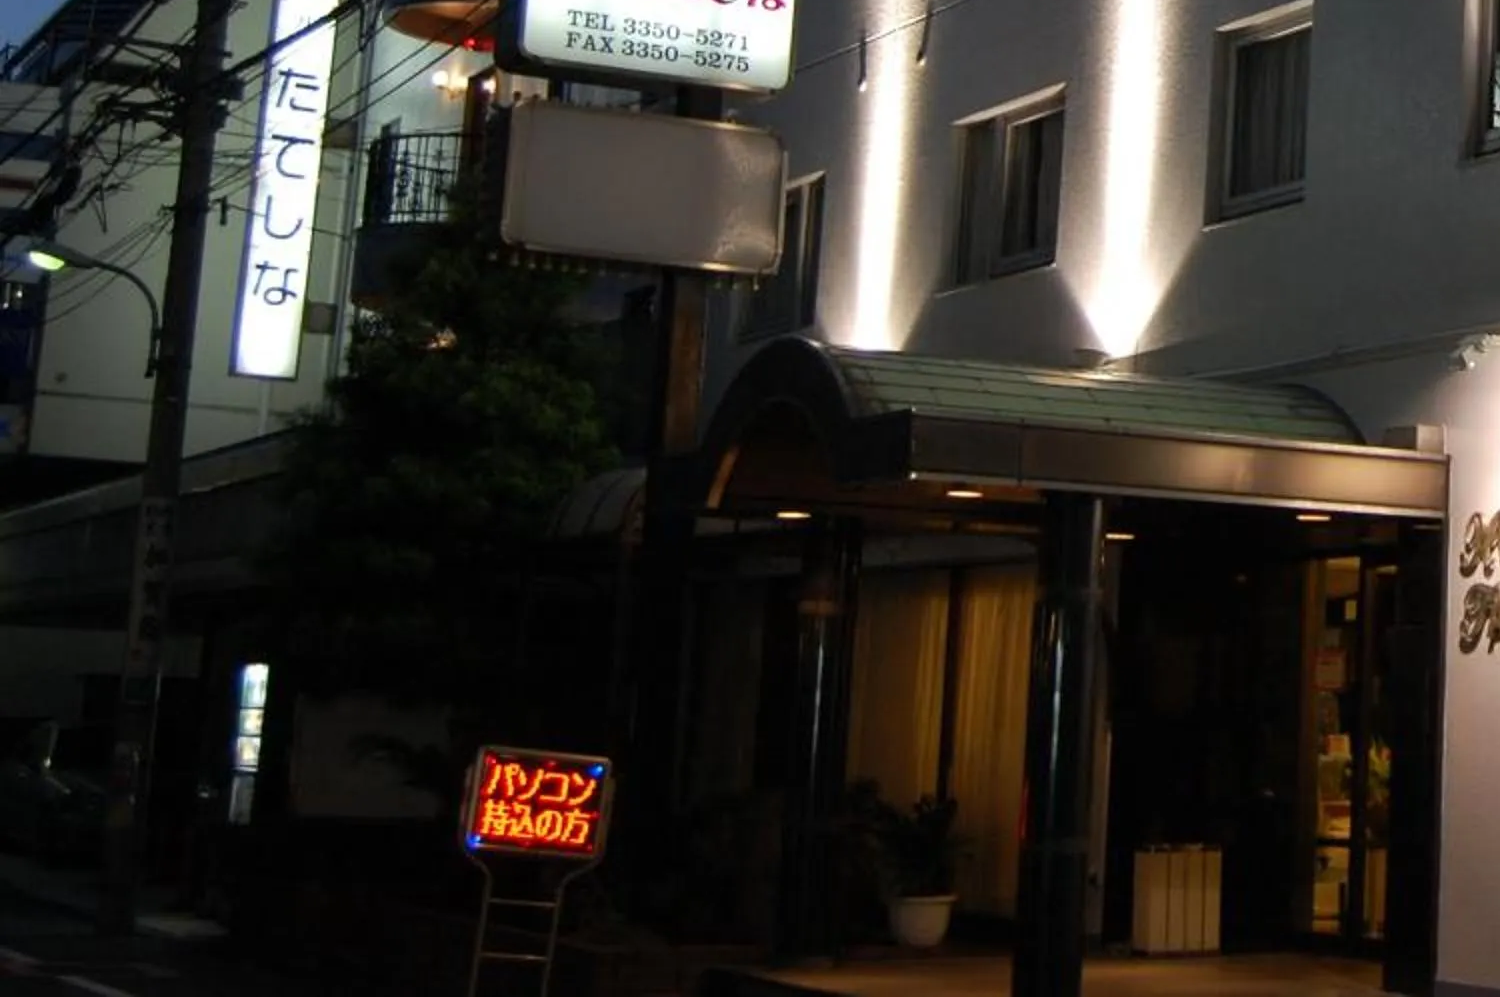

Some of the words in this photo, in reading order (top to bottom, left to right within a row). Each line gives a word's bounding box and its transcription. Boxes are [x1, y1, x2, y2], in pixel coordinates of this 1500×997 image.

[565, 31, 614, 54] FAX
[621, 39, 750, 72] 3350-5275
[567, 9, 615, 32] TEL
[623, 17, 749, 51] 3350-5271
[253, 68, 320, 306] たてしな
[487, 762, 597, 805] パソコン
[480, 798, 592, 844] 持込の方
